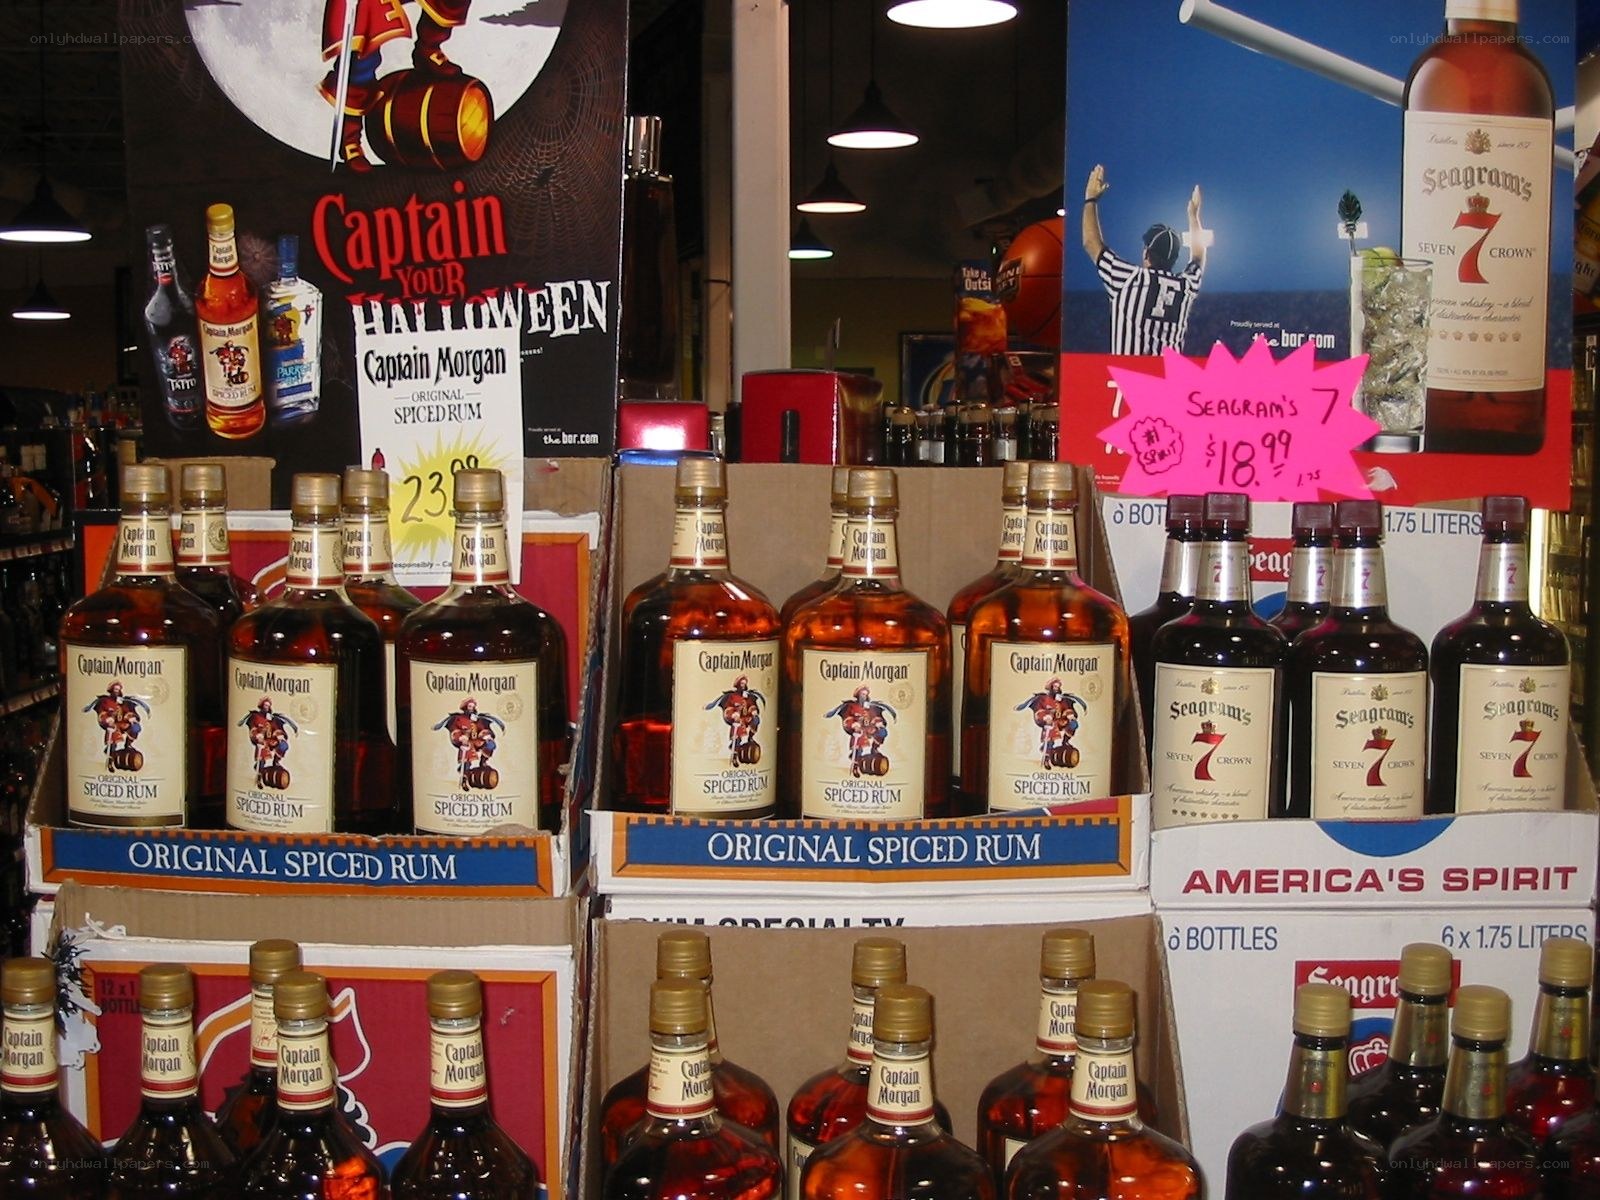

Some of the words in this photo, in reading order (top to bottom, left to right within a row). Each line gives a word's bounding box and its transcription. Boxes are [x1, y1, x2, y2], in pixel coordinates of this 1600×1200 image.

[1422, 166, 1532, 202] Seagram's
[312, 180, 508, 284] Captain
[1418, 242, 1456, 256] SEVEN
[1452, 210, 1502, 284] 7
[1489, 247, 1533, 259] CROWN
[395, 261, 466, 298] YOUR
[1151, 275, 1181, 317] F
[346, 280, 611, 339] HALLOWEEN
[364, 346, 430, 388] Captain
[434, 346, 506, 384] Morgan
[411, 389, 465, 403] ORIGINAL
[1312, 388, 1339, 424] 7
[394, 405, 446, 424] SPICED
[448, 403, 482, 423] RUM
[1385, 512, 1416, 533] 1.75
[1422, 513, 1483, 536] LITERS
[291, 537, 314, 555] Captai
[460, 534, 494, 552] Capain
[288, 553, 314, 571] Morga
[392, 561, 434, 569] esponsibly
[77, 654, 114, 675] Captain
[113, 656, 162, 679] Morgan
[699, 650, 740, 672] Captain
[740, 650, 773, 672] Morgan
[819, 659, 861, 681] Captain
[861, 660, 908, 682] Morgan
[1010, 651, 1053, 674] Captain
[1053, 653, 1098, 675] Morgan
[234, 667, 265, 689] Captain
[263, 671, 311, 696] Morgan
[426, 670, 467, 694] Captain
[467, 672, 516, 695] Morgan
[1170, 700, 1252, 725] Seagram's
[1335, 707, 1414, 729] Seagram's
[1483, 699, 1560, 721] Seagram's
[1166, 751, 1194, 762] SEVEN
[1191, 732, 1227, 782] 7
[1332, 760, 1365, 769] SEVEN
[1362, 737, 1397, 787] 7
[1480, 751, 1512, 761] SEVEN
[1509, 730, 1543, 778] 7
[97, 775, 140, 784] ORIGINAL
[721, 769, 757, 778] ORIGINAL
[841, 780, 885, 789] ORIGINAL
[1032, 772, 1075, 781] ORIGINAL
[83, 782, 125, 798] SPICED
[126, 784, 158, 800] RUM
[248, 790, 287, 802] ORIGINAL
[703, 778, 747, 795] SPICED
[748, 776, 769, 792] RUM
[824, 789, 869, 803] SPICED
[871, 789, 901, 804] RUM
[1014, 781, 1060, 795] SPICED
[1063, 781, 1091, 794] RUM
[236, 798, 272, 815] SPICED
[274, 803, 304, 819] RUM
[434, 800, 479, 816] SPICED
[482, 802, 513, 817] RUM
[450, 793, 495, 802] ORIGINAL
[707, 832, 861, 864] ORIGINAL
[867, 834, 969, 866] SPICED
[976, 833, 1042, 866] RUM
[127, 840, 278, 875] ORIGINAL
[284, 850, 385, 881] SPICED
[391, 852, 458, 882] RUM
[1182, 867, 1425, 894] AMERICA'S
[1442, 866, 1578, 892] SPIRIT
[1186, 926, 1278, 951] BOTTLES
[1441, 925, 1455, 949] 6
[1458, 931, 1471, 949] x
[1476, 925, 1513, 949] 1.75
[1050, 1000, 1076, 1019] Capta
[1049, 1019, 1076, 1037] Morg
[281, 1045, 321, 1067] Captain
[281, 1065, 323, 1086] Morgan
[681, 1060, 711, 1080] Capta
[880, 1065, 920, 1088] Captain
[1088, 1061, 1127, 1083] Captain
[681, 1080, 713, 1101] Morg
[878, 1085, 922, 1107] Morgan
[1087, 1081, 1129, 1101] Morgan
